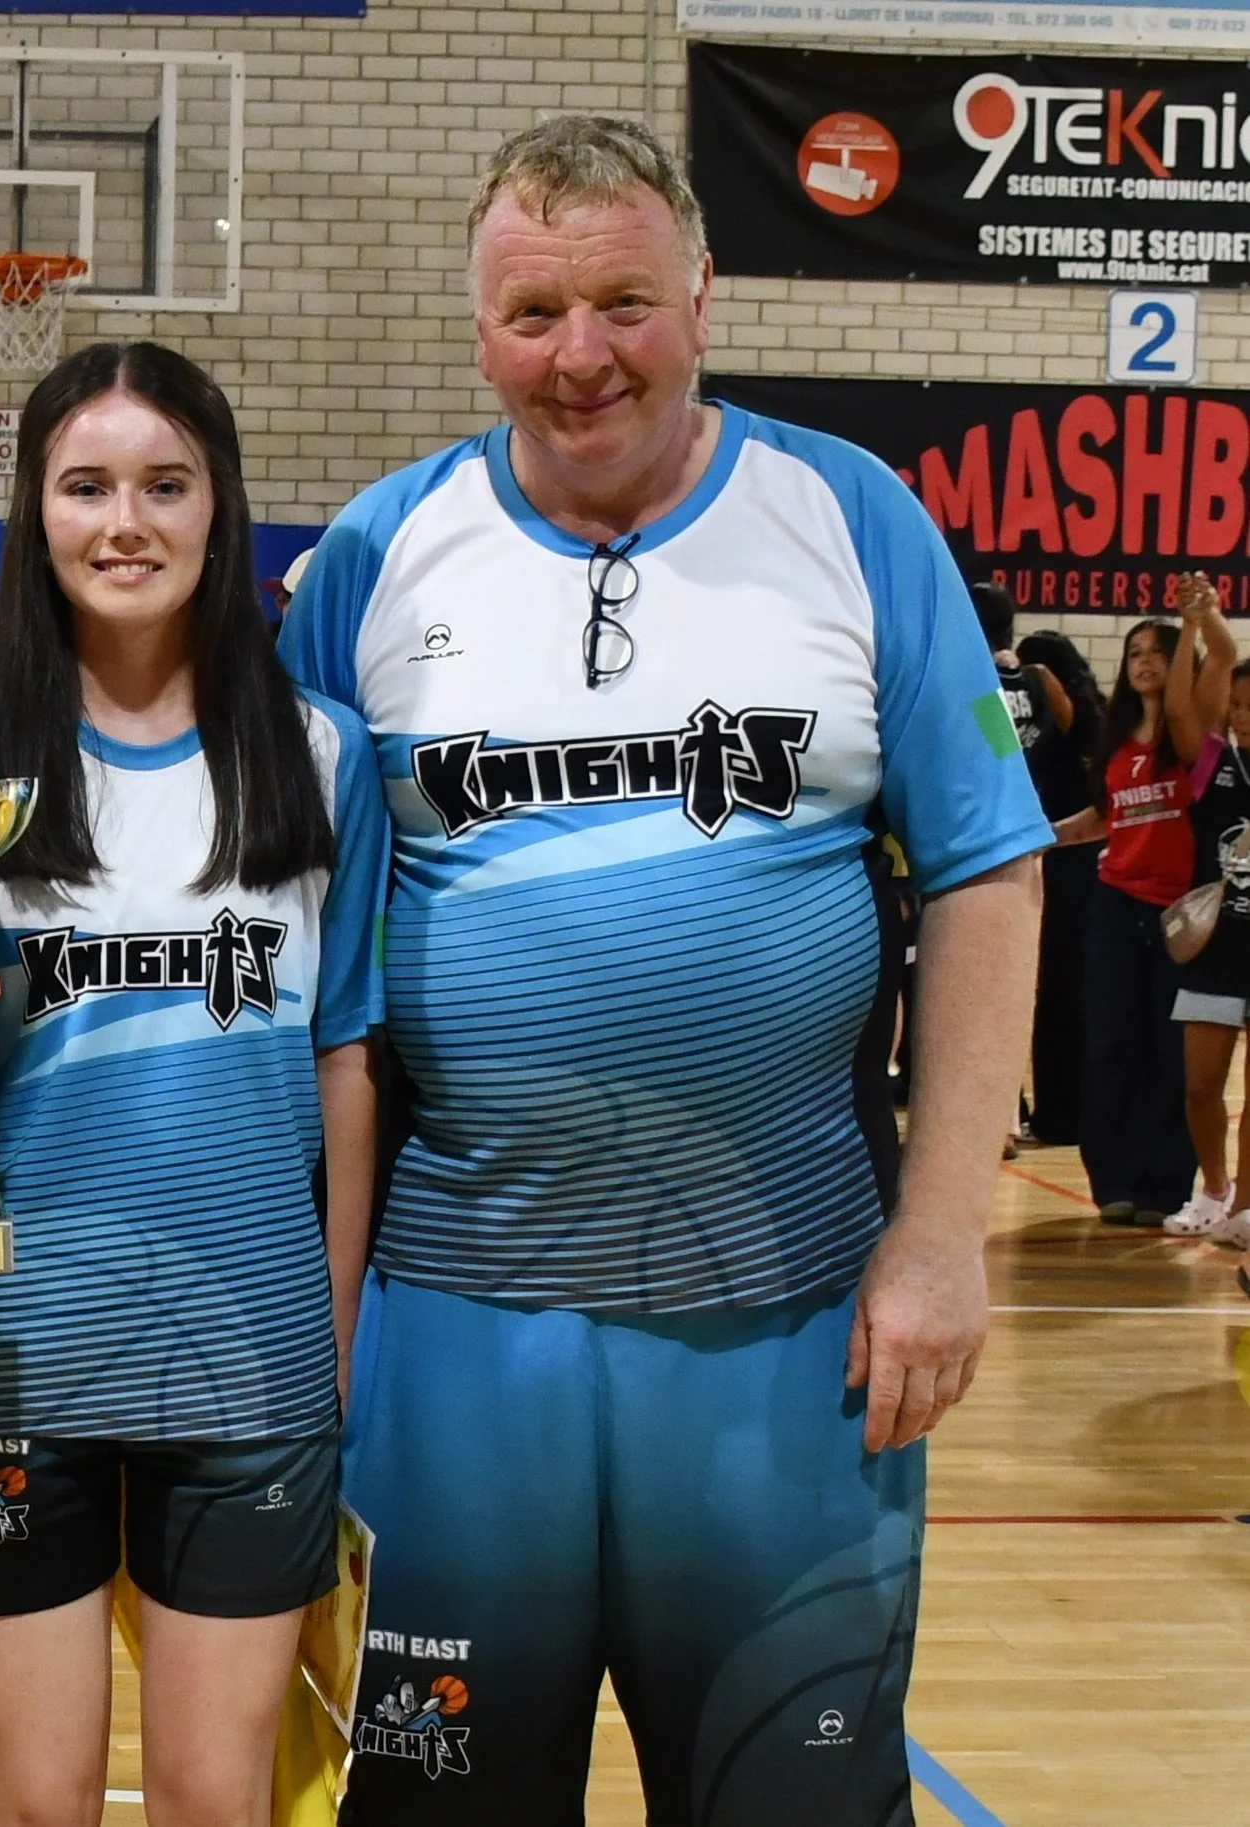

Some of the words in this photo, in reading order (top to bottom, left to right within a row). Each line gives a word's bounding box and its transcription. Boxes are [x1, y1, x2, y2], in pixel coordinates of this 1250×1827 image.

[835, 8, 881, 21] LLORET
[953, 73, 1250, 200] 9TEKni
[978, 224, 1106, 257] SISTEMES
[1111, 229, 1144, 259] DE
[1058, 261, 1210, 283] www.9teknic.cat
[1128, 302, 1177, 372] 2
[894, 394, 1249, 557] MASHB
[411, 699, 817, 840] KNIGHTS
[1131, 755, 1147, 778] 7
[15, 906, 288, 1032] KNIGHTS
[410, 1637, 472, 1661] EAST
